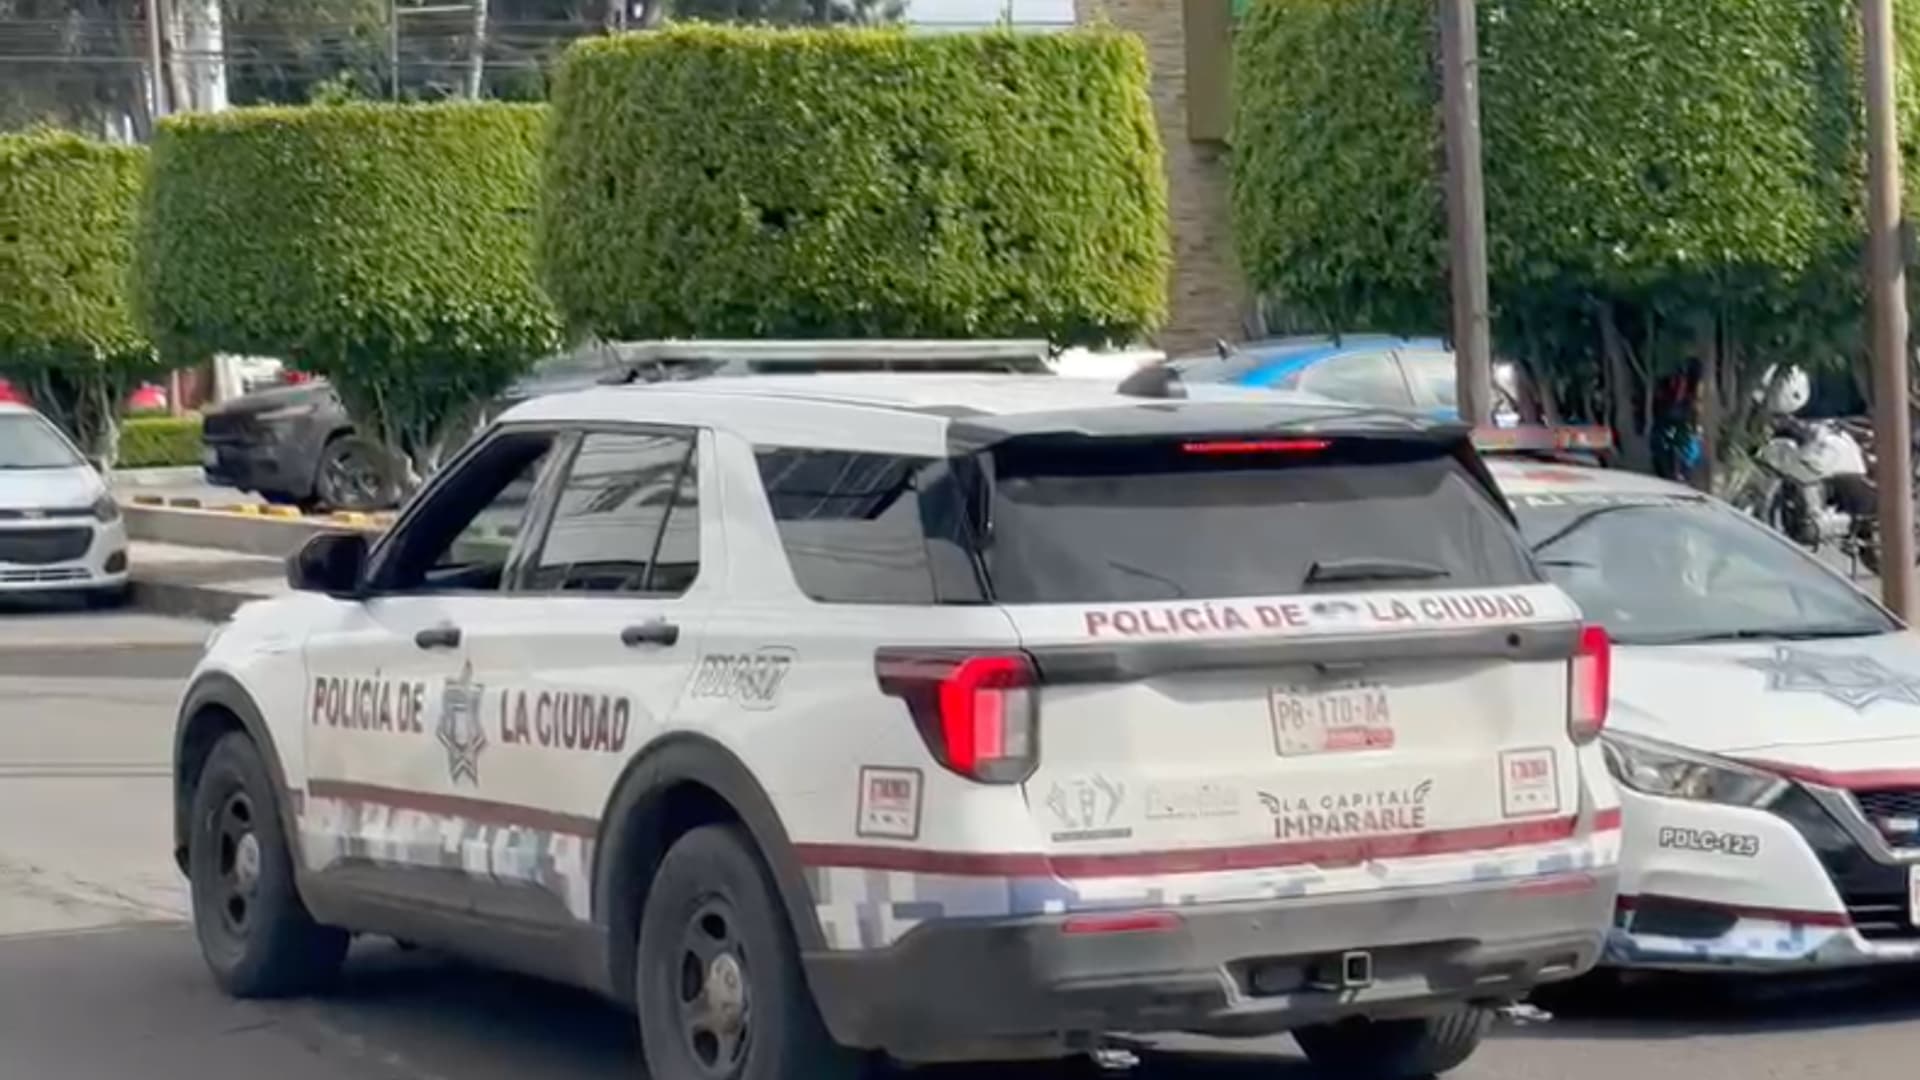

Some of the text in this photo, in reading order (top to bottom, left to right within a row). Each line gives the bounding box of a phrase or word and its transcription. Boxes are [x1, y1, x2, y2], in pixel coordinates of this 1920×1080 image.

[1085, 594, 1535, 636] POLICÍA DE LA CIUDAD
[312, 667, 630, 752] POLICÍA DE LA CIUDAD
[1283, 789, 1410, 812] LA CAPITAL
[1274, 806, 1426, 839] IMPARABLE
[1660, 827, 1760, 857] PDLC-125
